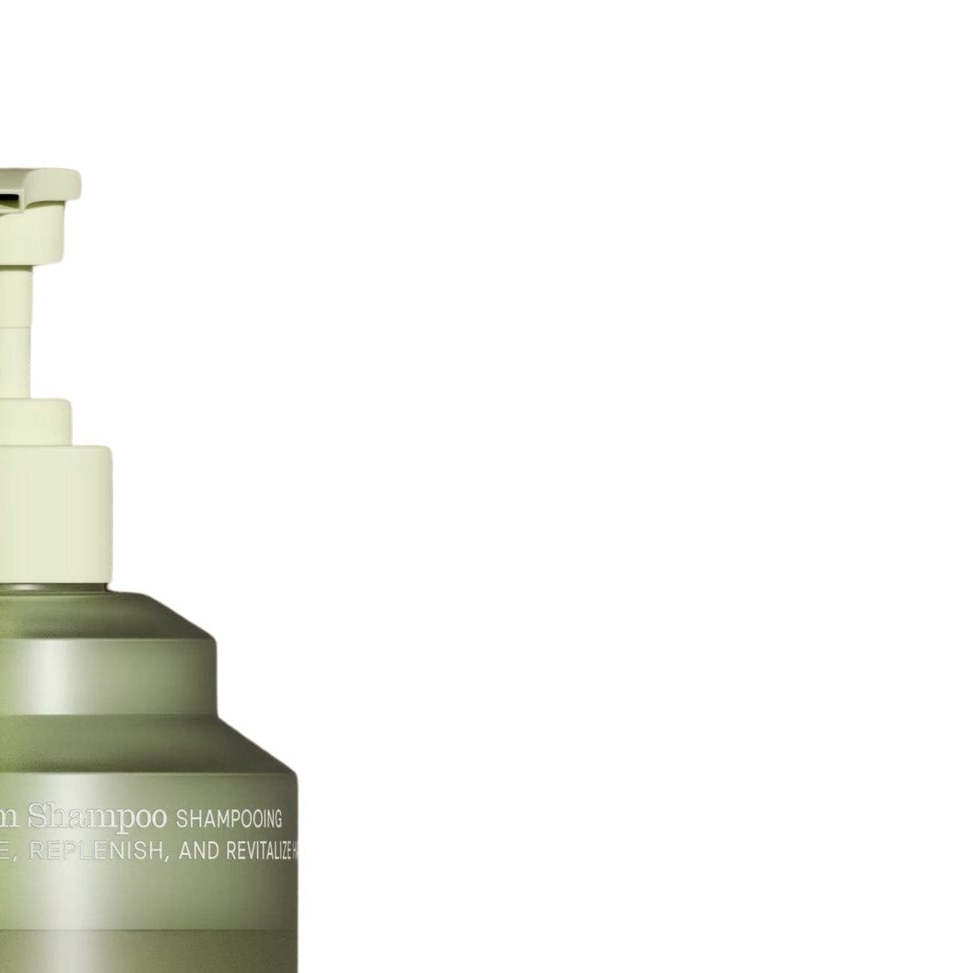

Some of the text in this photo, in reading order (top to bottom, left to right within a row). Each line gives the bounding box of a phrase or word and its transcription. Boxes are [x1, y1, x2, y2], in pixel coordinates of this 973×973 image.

[27, 801, 168, 835] Shampoo
[176, 809, 283, 828] SHAMPOOING
[29, 840, 169, 863] REPLENISH,
[178, 841, 220, 860] AND
[226, 841, 292, 860] REVITALIZE
